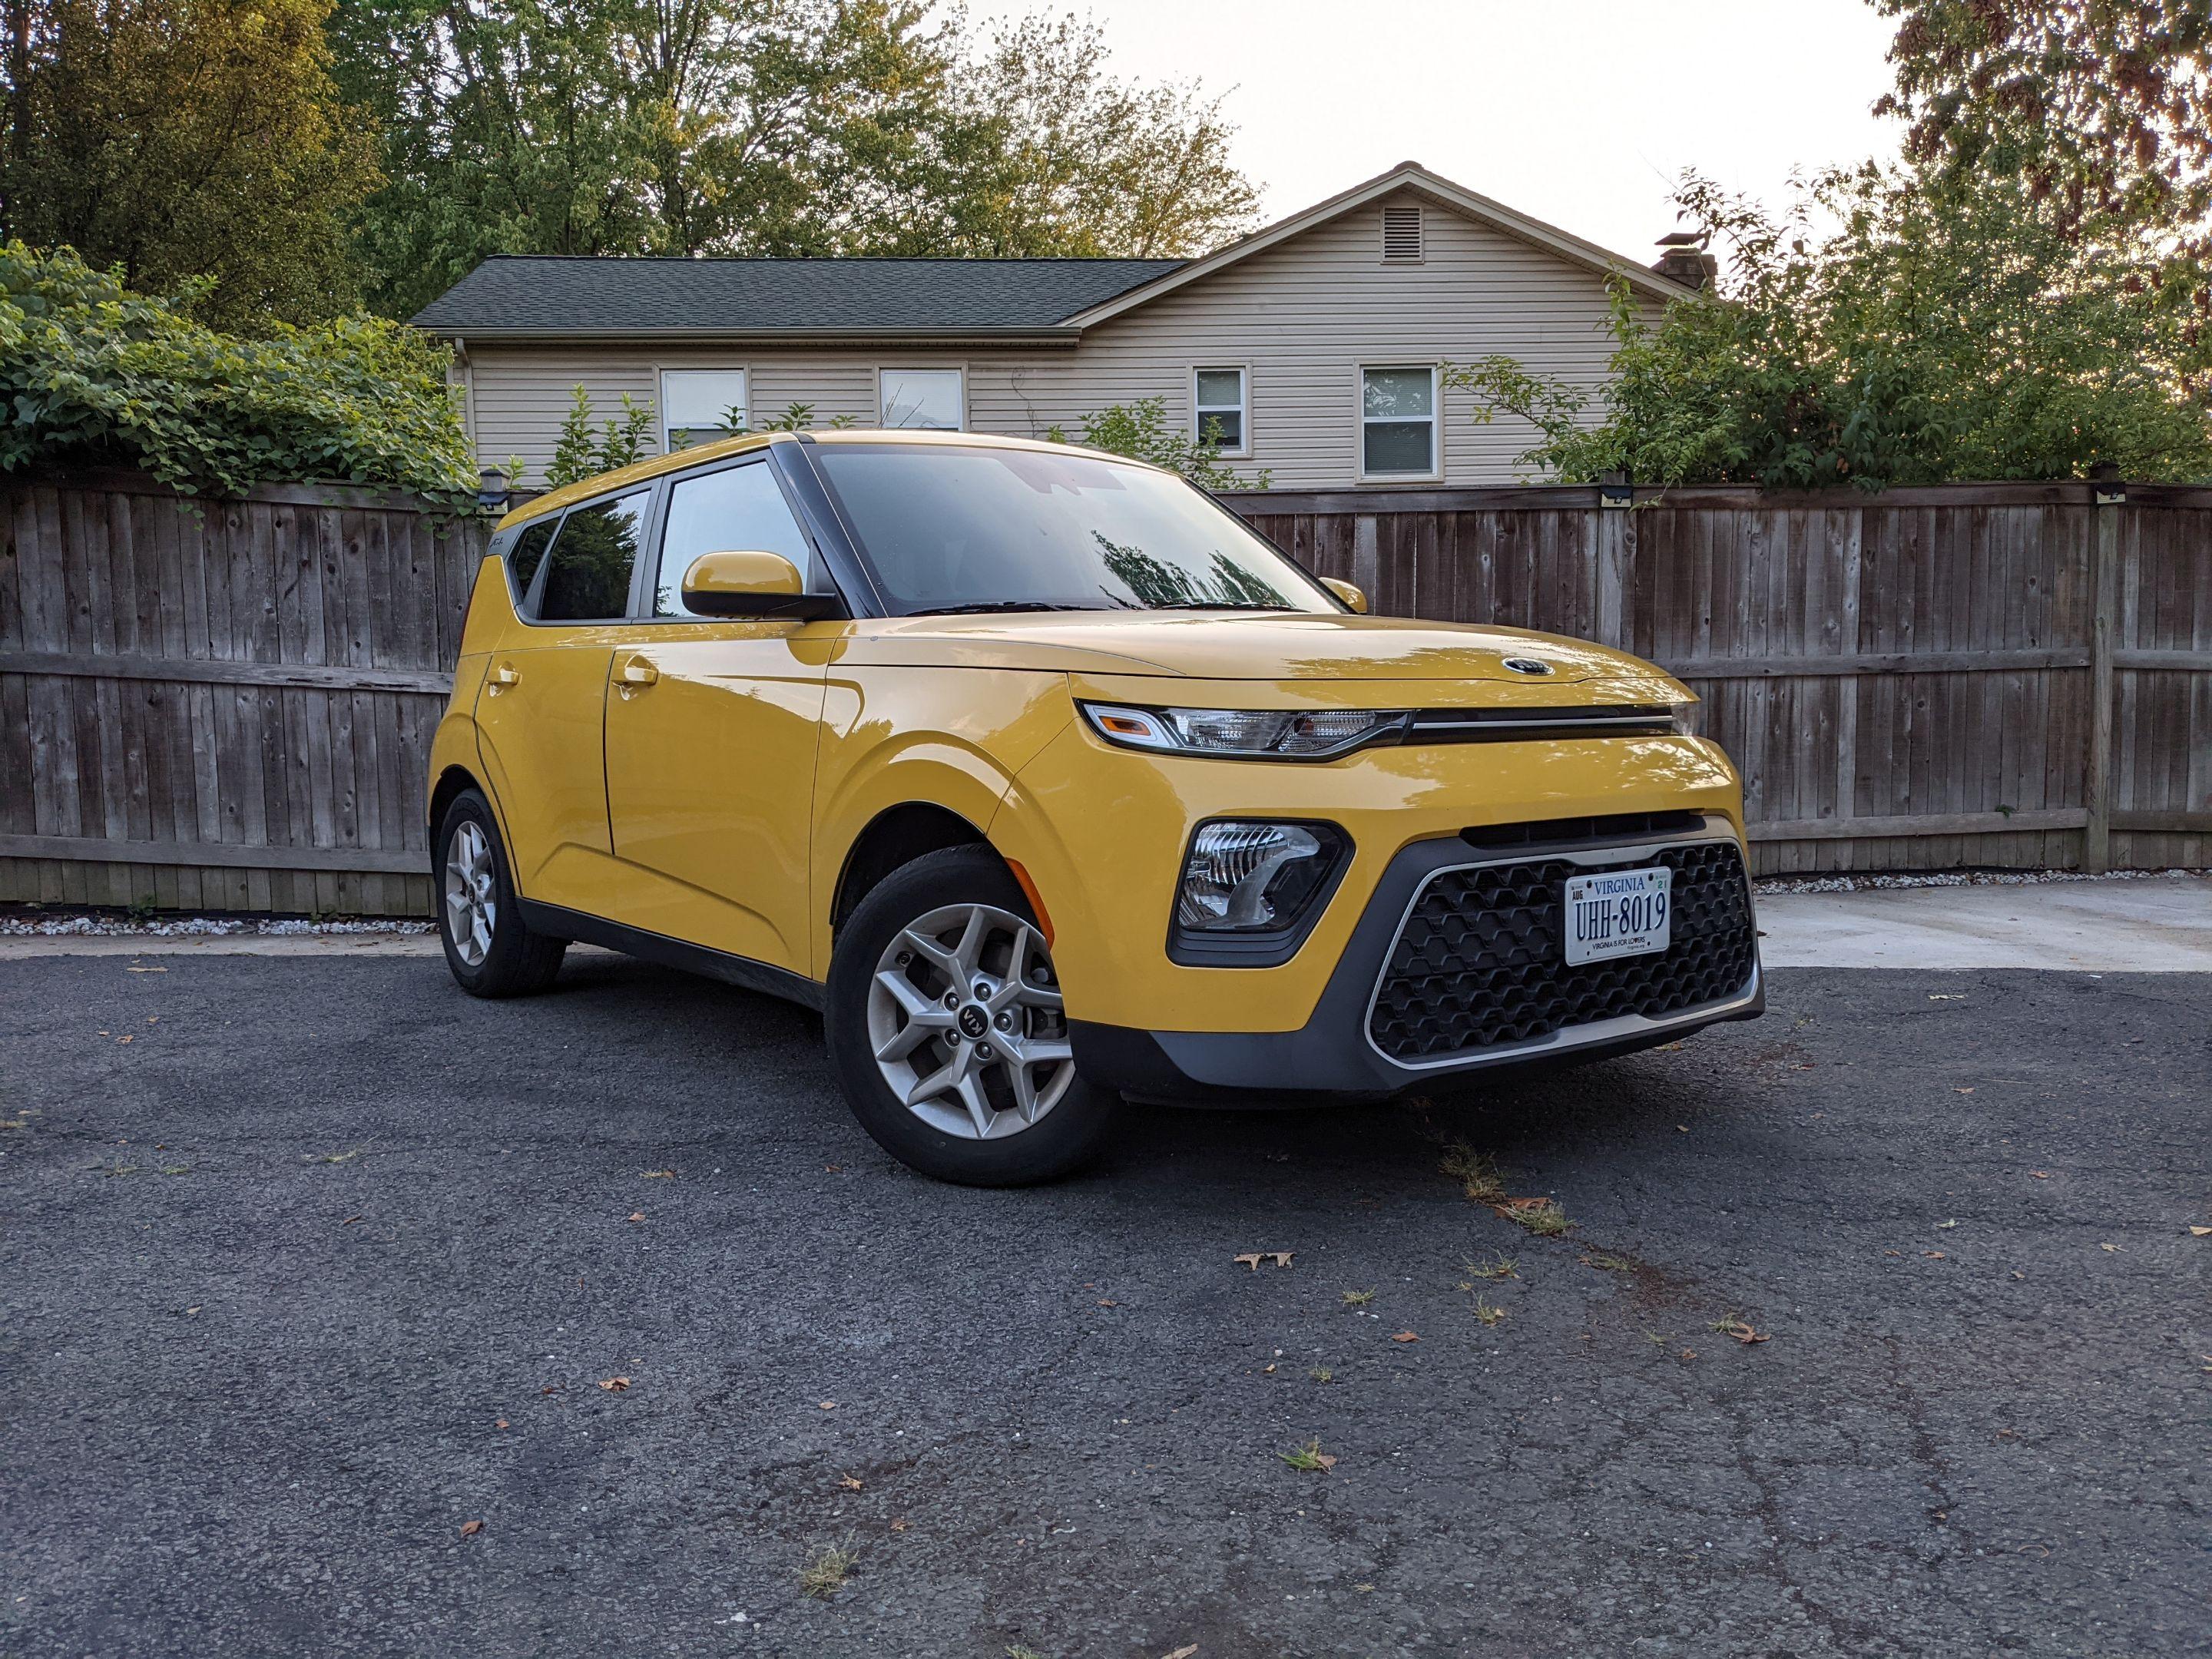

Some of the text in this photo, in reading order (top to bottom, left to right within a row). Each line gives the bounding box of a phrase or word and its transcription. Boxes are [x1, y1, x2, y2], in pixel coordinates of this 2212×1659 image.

[1594, 876, 1645, 896] VIRGINIA
[1657, 880, 1667, 889] 21
[1572, 889, 1584, 902] AUG
[1575, 892, 1666, 941] UHH-8019
[1592, 942, 1613, 950] VIRGINIA
[1618, 939, 1628, 947] FOR
[963, 1008, 983, 1035] KIA
